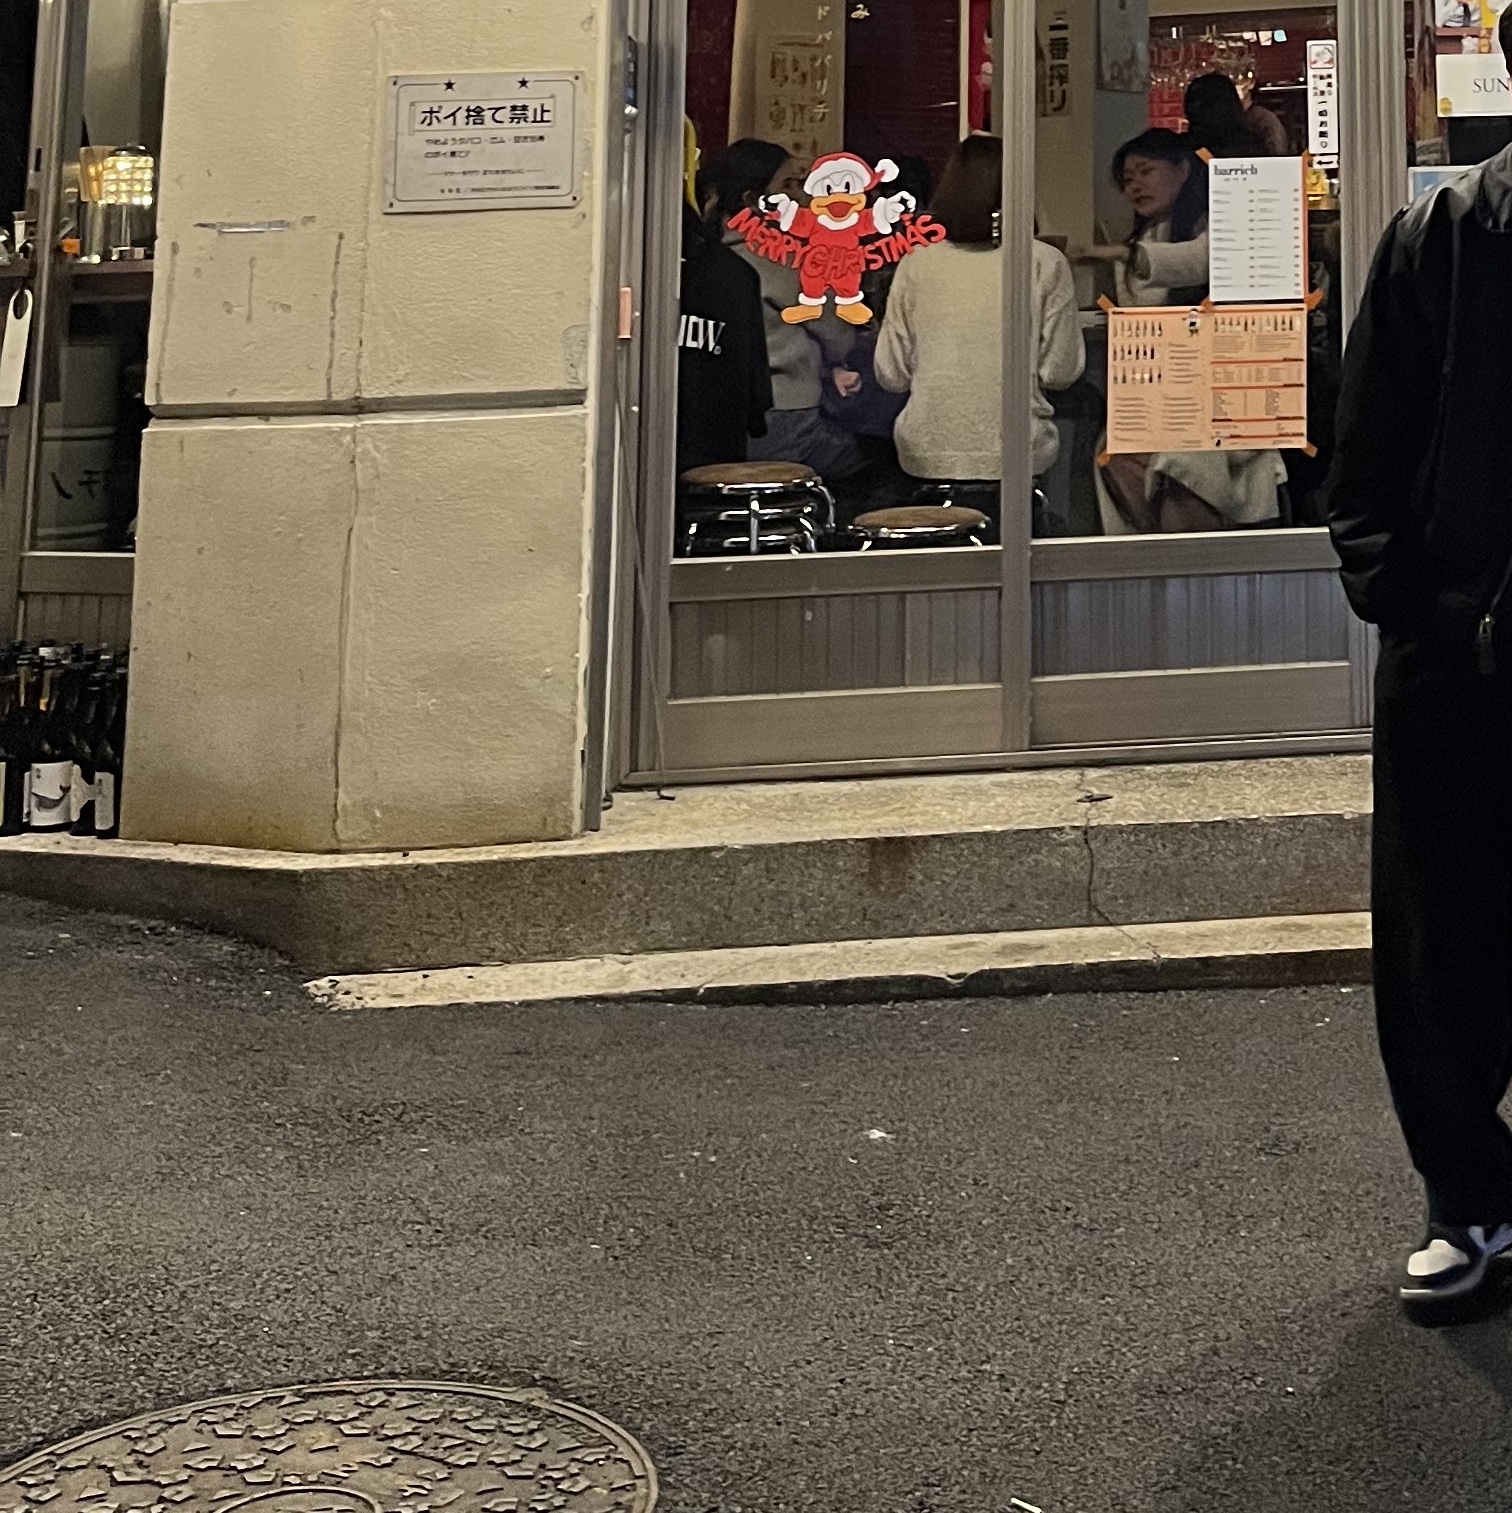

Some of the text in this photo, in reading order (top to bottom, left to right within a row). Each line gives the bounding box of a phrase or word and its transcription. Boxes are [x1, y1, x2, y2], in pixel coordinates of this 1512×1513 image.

[1048, 25, 1068, 113] 一番搾り
[420, 103, 552, 126] ポイ捨て禁止
[1214, 164, 1258, 176] barrich
[727, 207, 947, 280] MERRY CHRISTMAS
